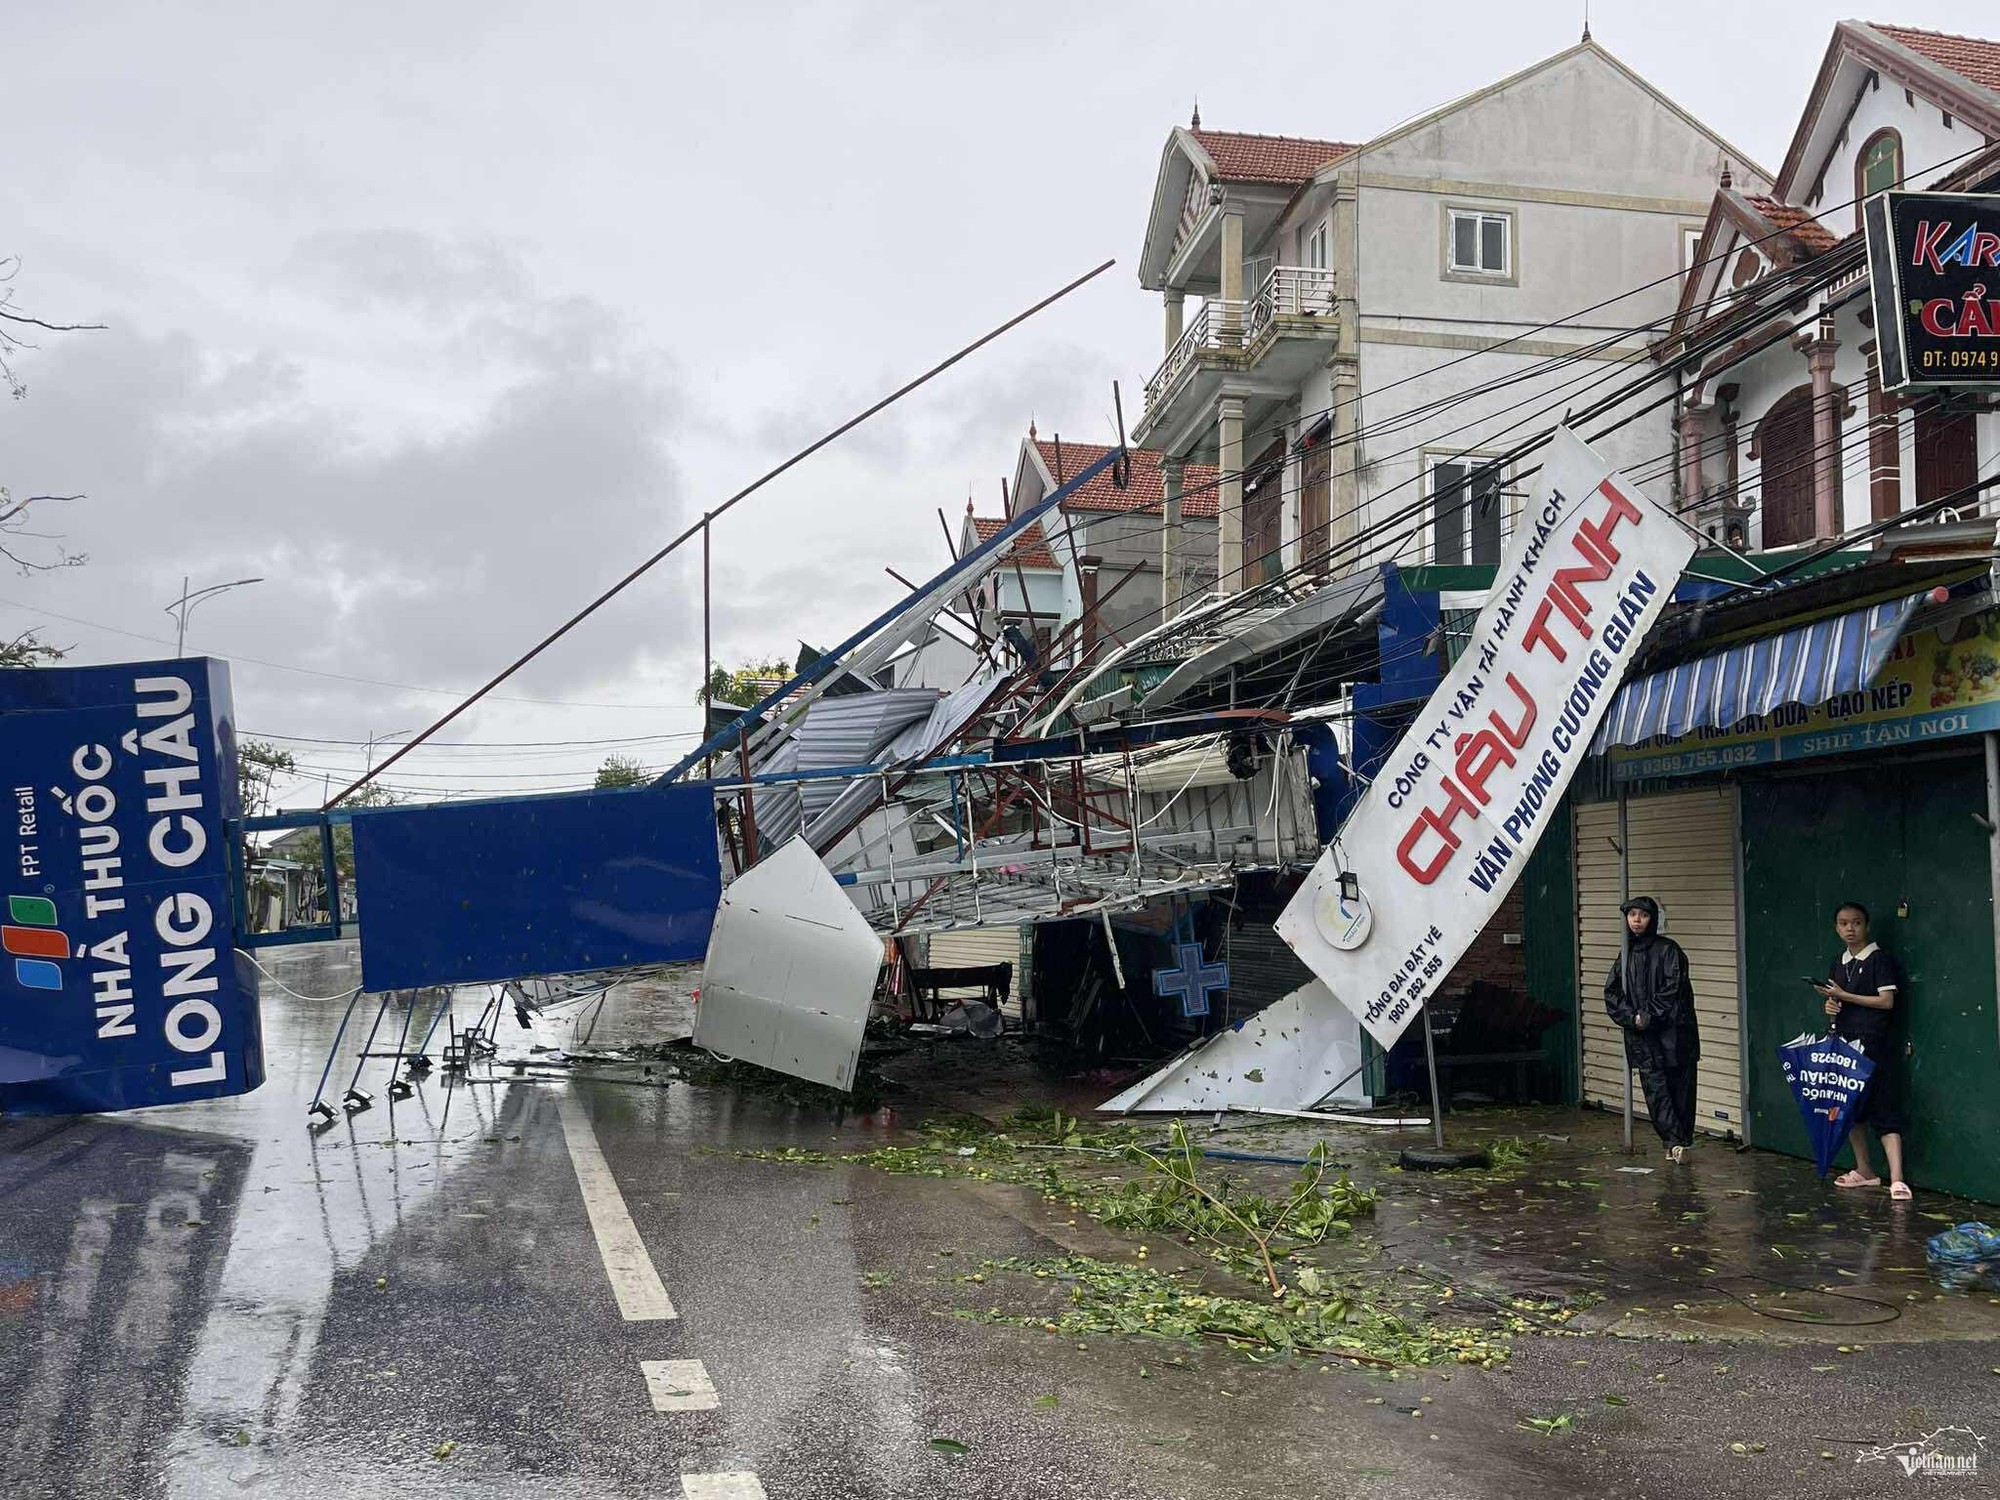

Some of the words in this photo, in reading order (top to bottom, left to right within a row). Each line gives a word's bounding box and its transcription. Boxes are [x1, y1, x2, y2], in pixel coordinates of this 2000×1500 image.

[1912, 221, 2000, 275] KAR
[1923, 351, 1947, 367] ĐT:
[1387, 752, 1431, 809] CÔNG
[1426, 720, 1451, 750] TY
[1448, 675, 1485, 719] VẬN
[1492, 574, 1528, 640] HÀNH
[1521, 488, 1566, 575] KHÁCH
[1397, 671, 1538, 886] CHÂU
[1521, 477, 1644, 664] TỊNH
[1872, 677, 1913, 712] NẾP
[122, 675, 207, 868] CHÂU
[1468, 835, 1514, 894] VĂN
[1501, 748, 1562, 844] PHÒNG
[1551, 648, 1610, 755] CƯƠNG
[1601, 568, 1658, 655] GIÁN
[1803, 732, 1854, 754] SHIP
[1861, 721, 1911, 747] TẬN
[1920, 714, 1969, 736] NƠI
[19, 786, 36, 836] Retail
[23, 843, 40, 877] FPT
[50, 743, 125, 920] THUỐC
[77, 930, 136, 1039] NHÀ
[155, 892, 227, 1087] LONG
[1364, 991, 1393, 1025] TỔNG
[1389, 968, 1409, 995] ĐÀI
[1404, 944, 1428, 973] ĐẶT
[1424, 924, 1443, 947] VÉ
[1388, 998, 1411, 1024] 1900
[1407, 977, 1427, 1001] 252
[1422, 955, 1444, 979] 555
